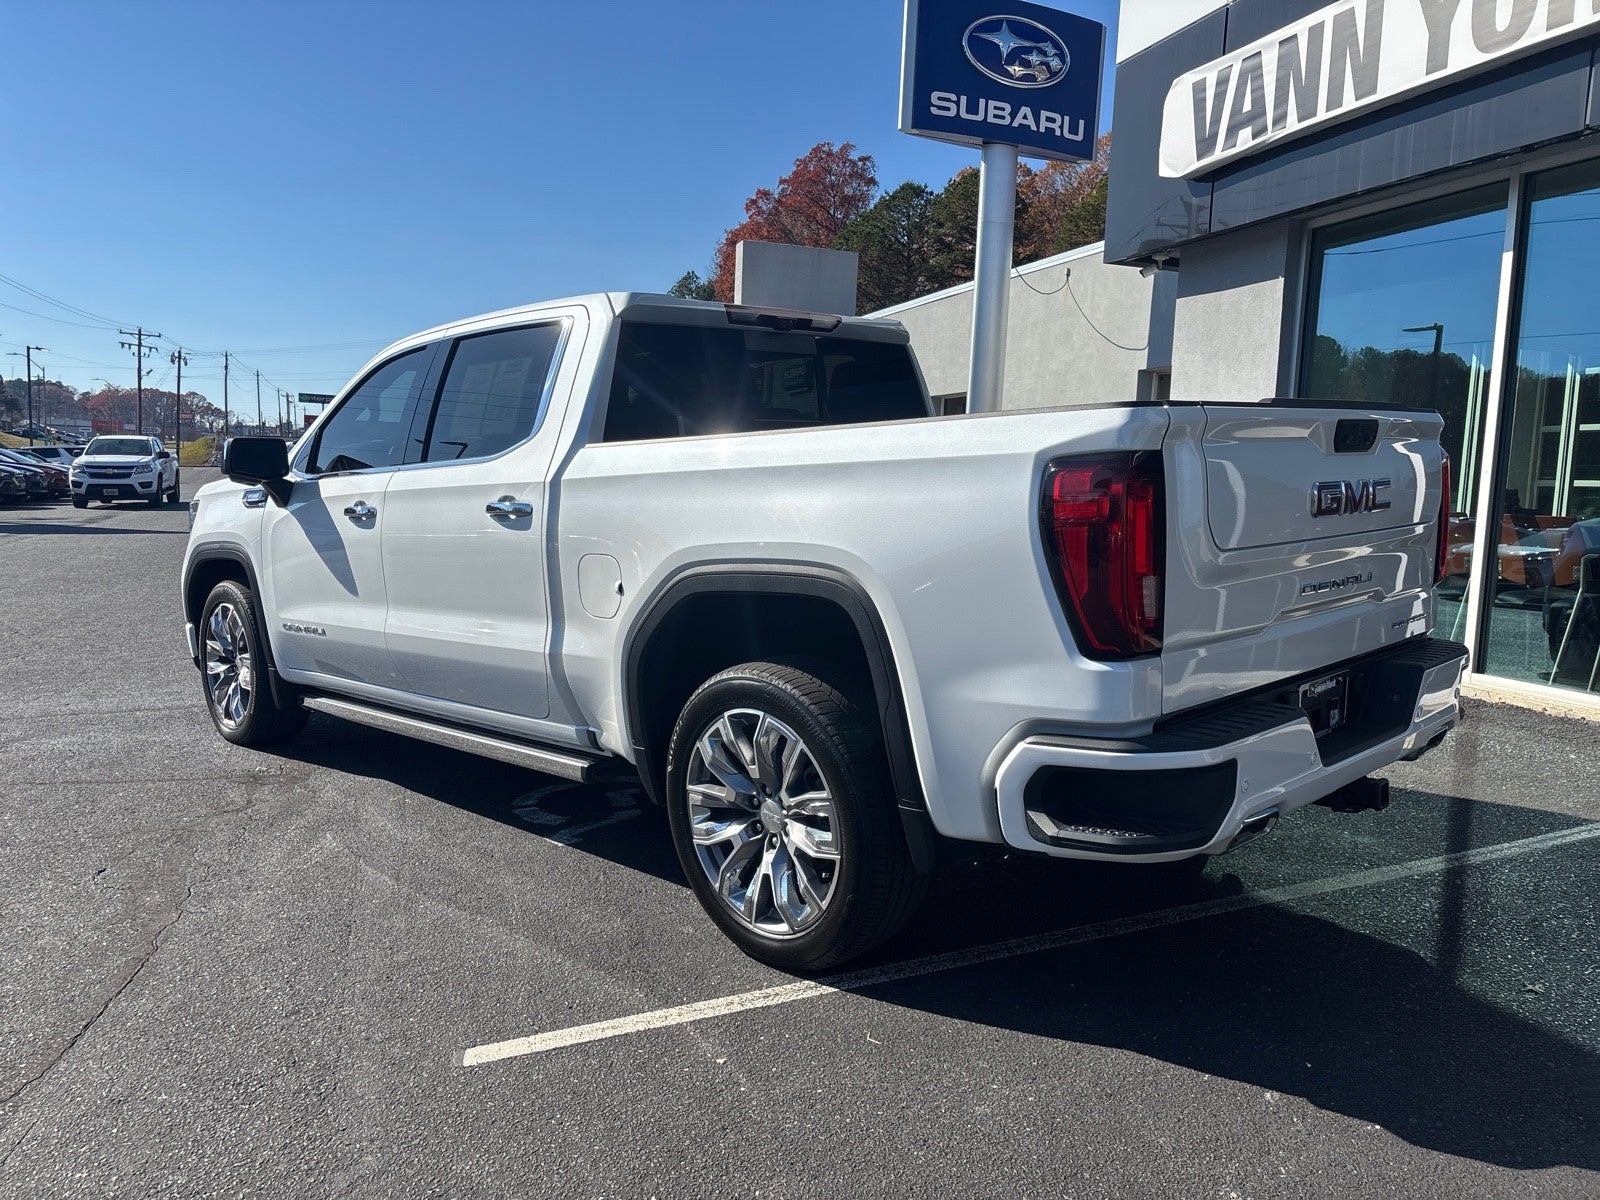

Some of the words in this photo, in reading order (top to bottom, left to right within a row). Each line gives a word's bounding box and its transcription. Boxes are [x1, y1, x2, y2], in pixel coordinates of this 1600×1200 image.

[1191, 0, 1385, 163] VANN
[930, 90, 1085, 142] SUBARU
[1311, 477, 1392, 519] GMC
[1301, 571, 1373, 597] DENALI
